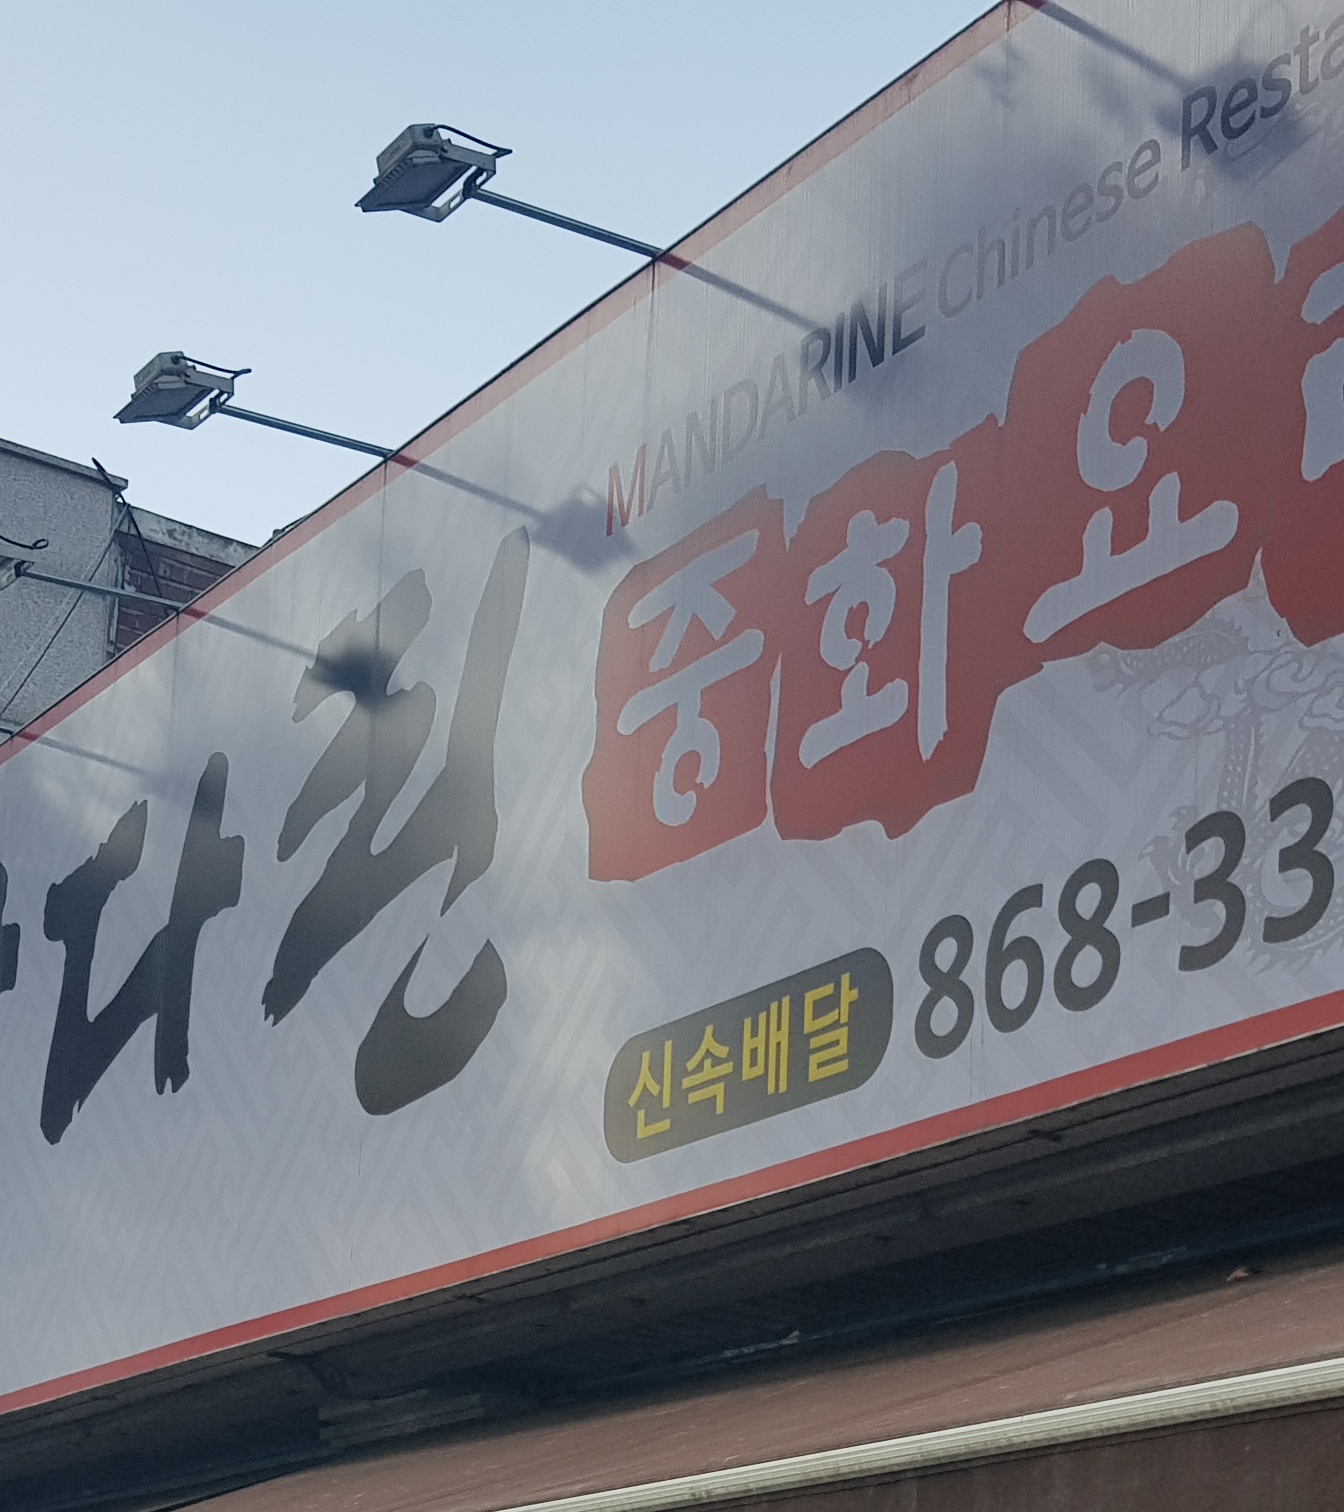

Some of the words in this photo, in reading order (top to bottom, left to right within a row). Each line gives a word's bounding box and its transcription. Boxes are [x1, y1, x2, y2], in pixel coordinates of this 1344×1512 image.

[605, 262, 928, 537] MANDARINE
[938, 138, 1162, 320] Chinese
[627, 972, 859, 1140] 신속배달
